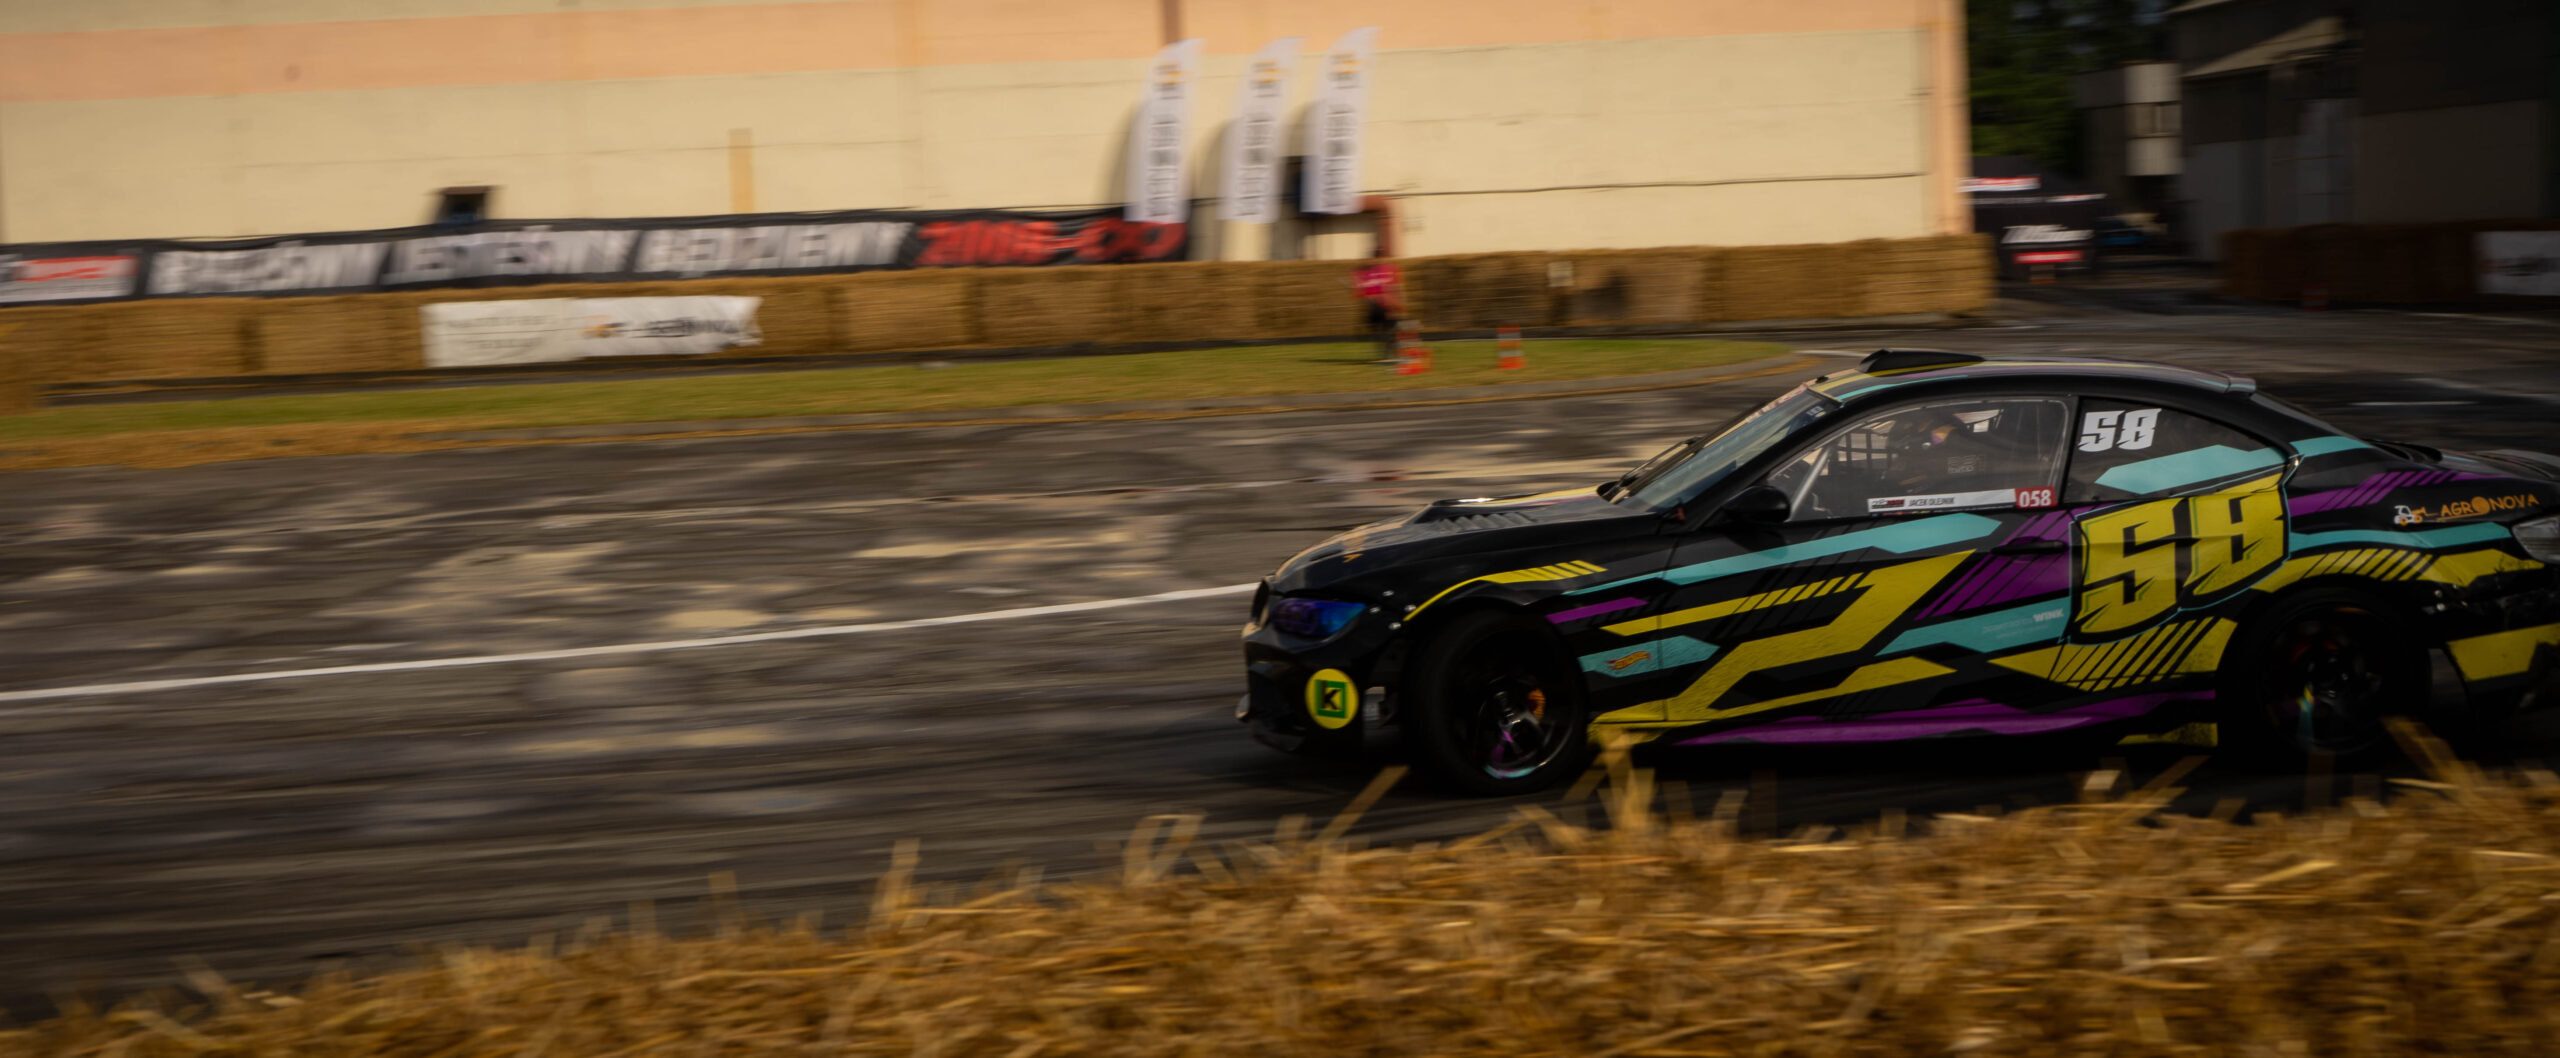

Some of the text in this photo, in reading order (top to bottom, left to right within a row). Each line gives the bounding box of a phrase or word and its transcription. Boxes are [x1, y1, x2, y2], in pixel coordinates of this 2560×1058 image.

[386, 225, 636, 284] JESTEŚMY
[635, 221, 913, 278] BĘDZIEMY
[2078, 408, 2162, 452] 58
[2019, 489, 2051, 508] 058
[2441, 494, 2539, 516] AGRONOVA
[2074, 472, 2284, 633] 58
[2033, 609, 2064, 622] WINK
[1321, 681, 1341, 710] K
